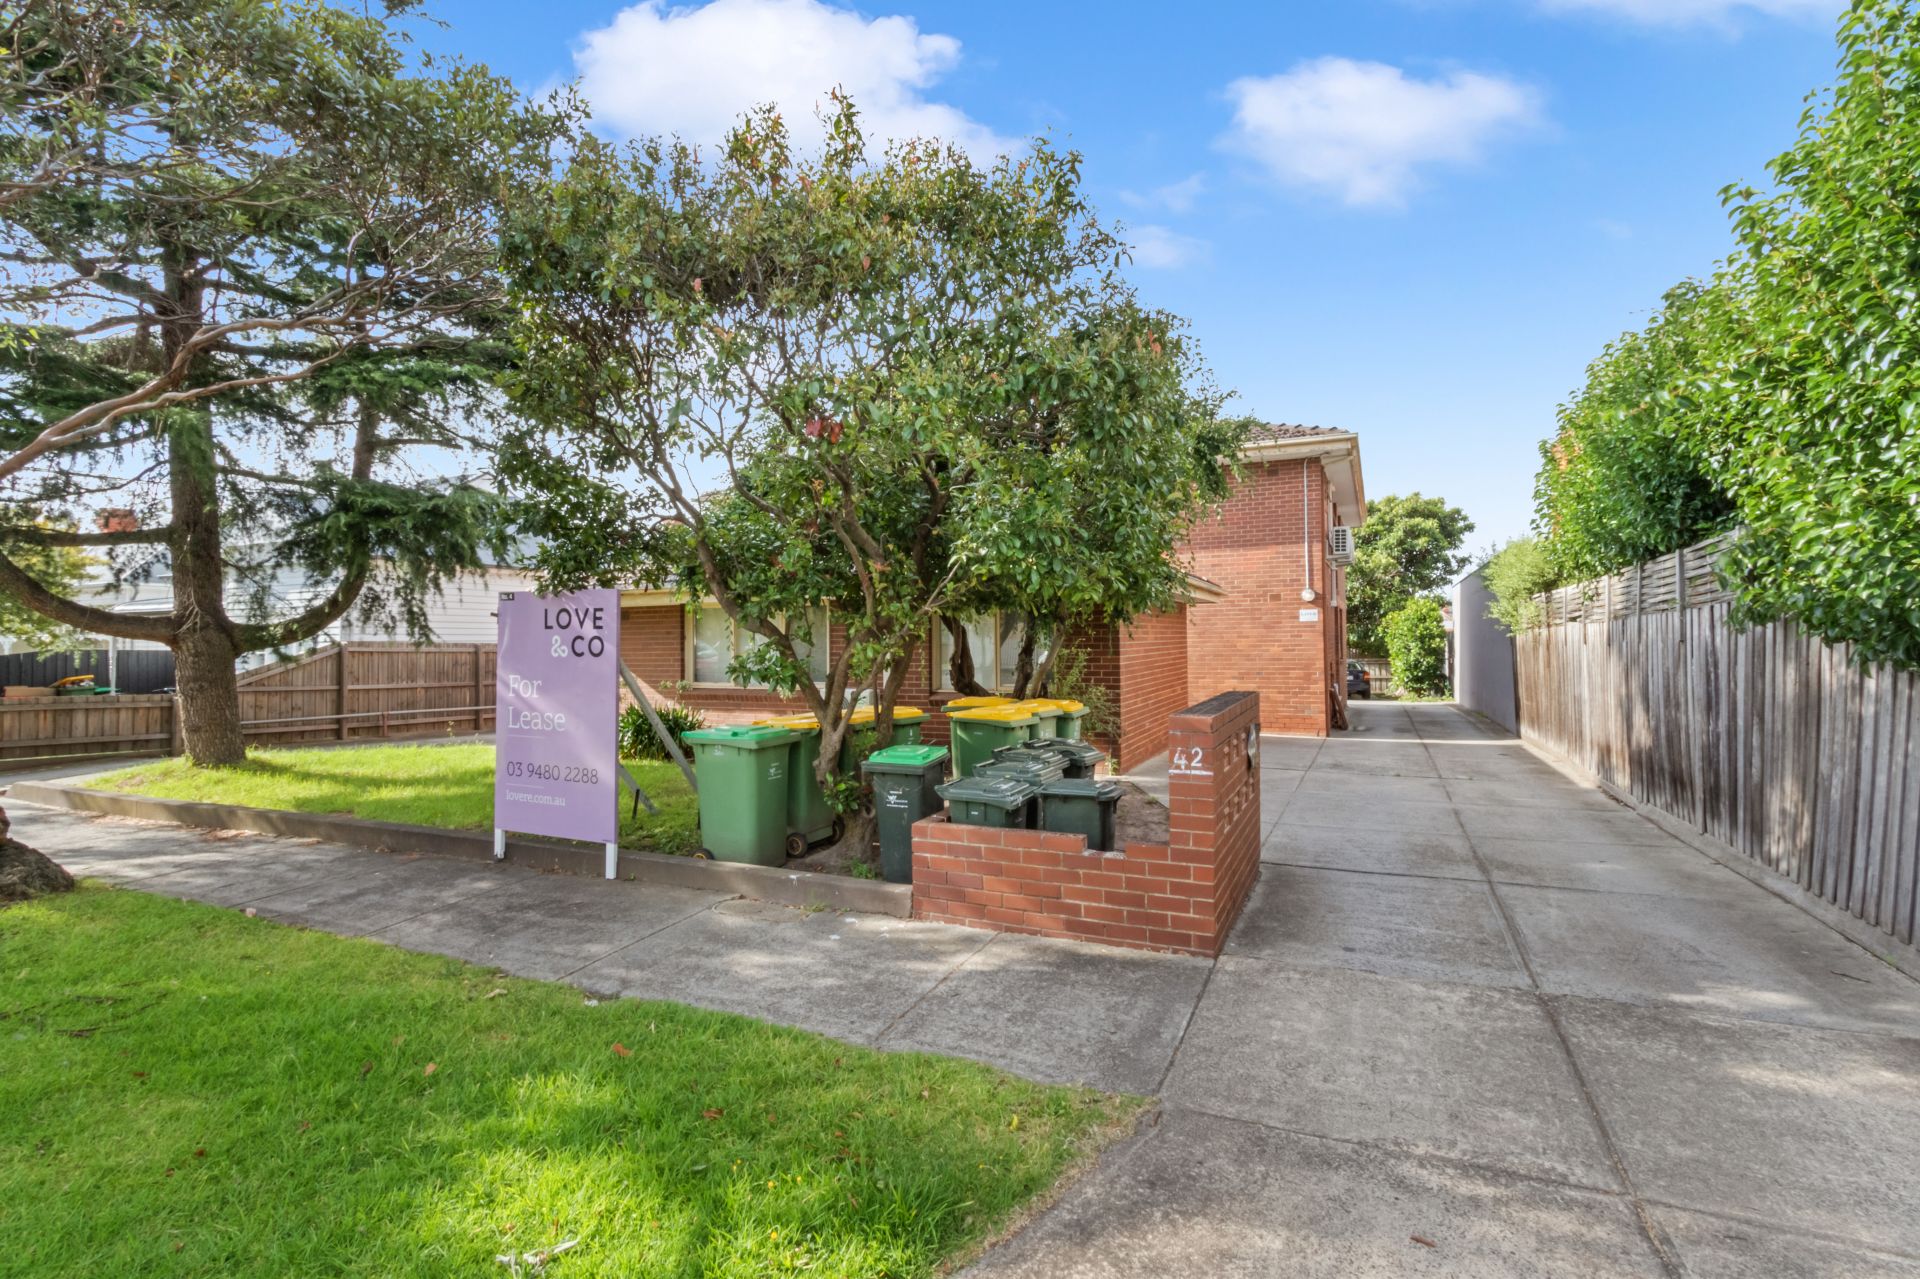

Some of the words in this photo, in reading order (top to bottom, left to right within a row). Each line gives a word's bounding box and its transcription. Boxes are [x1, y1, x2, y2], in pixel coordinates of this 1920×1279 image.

[544, 607, 604, 630] LOVE
[551, 634, 569, 658] &
[571, 635, 605, 658] CO
[508, 674, 542, 698] For
[508, 706, 566, 732] Lease
[1173, 746, 1203, 770] 42
[506, 761, 523, 777] 03
[526, 762, 561, 781] 9480
[563, 766, 599, 785] 2288
[505, 788, 567, 807] lovere.com.au
